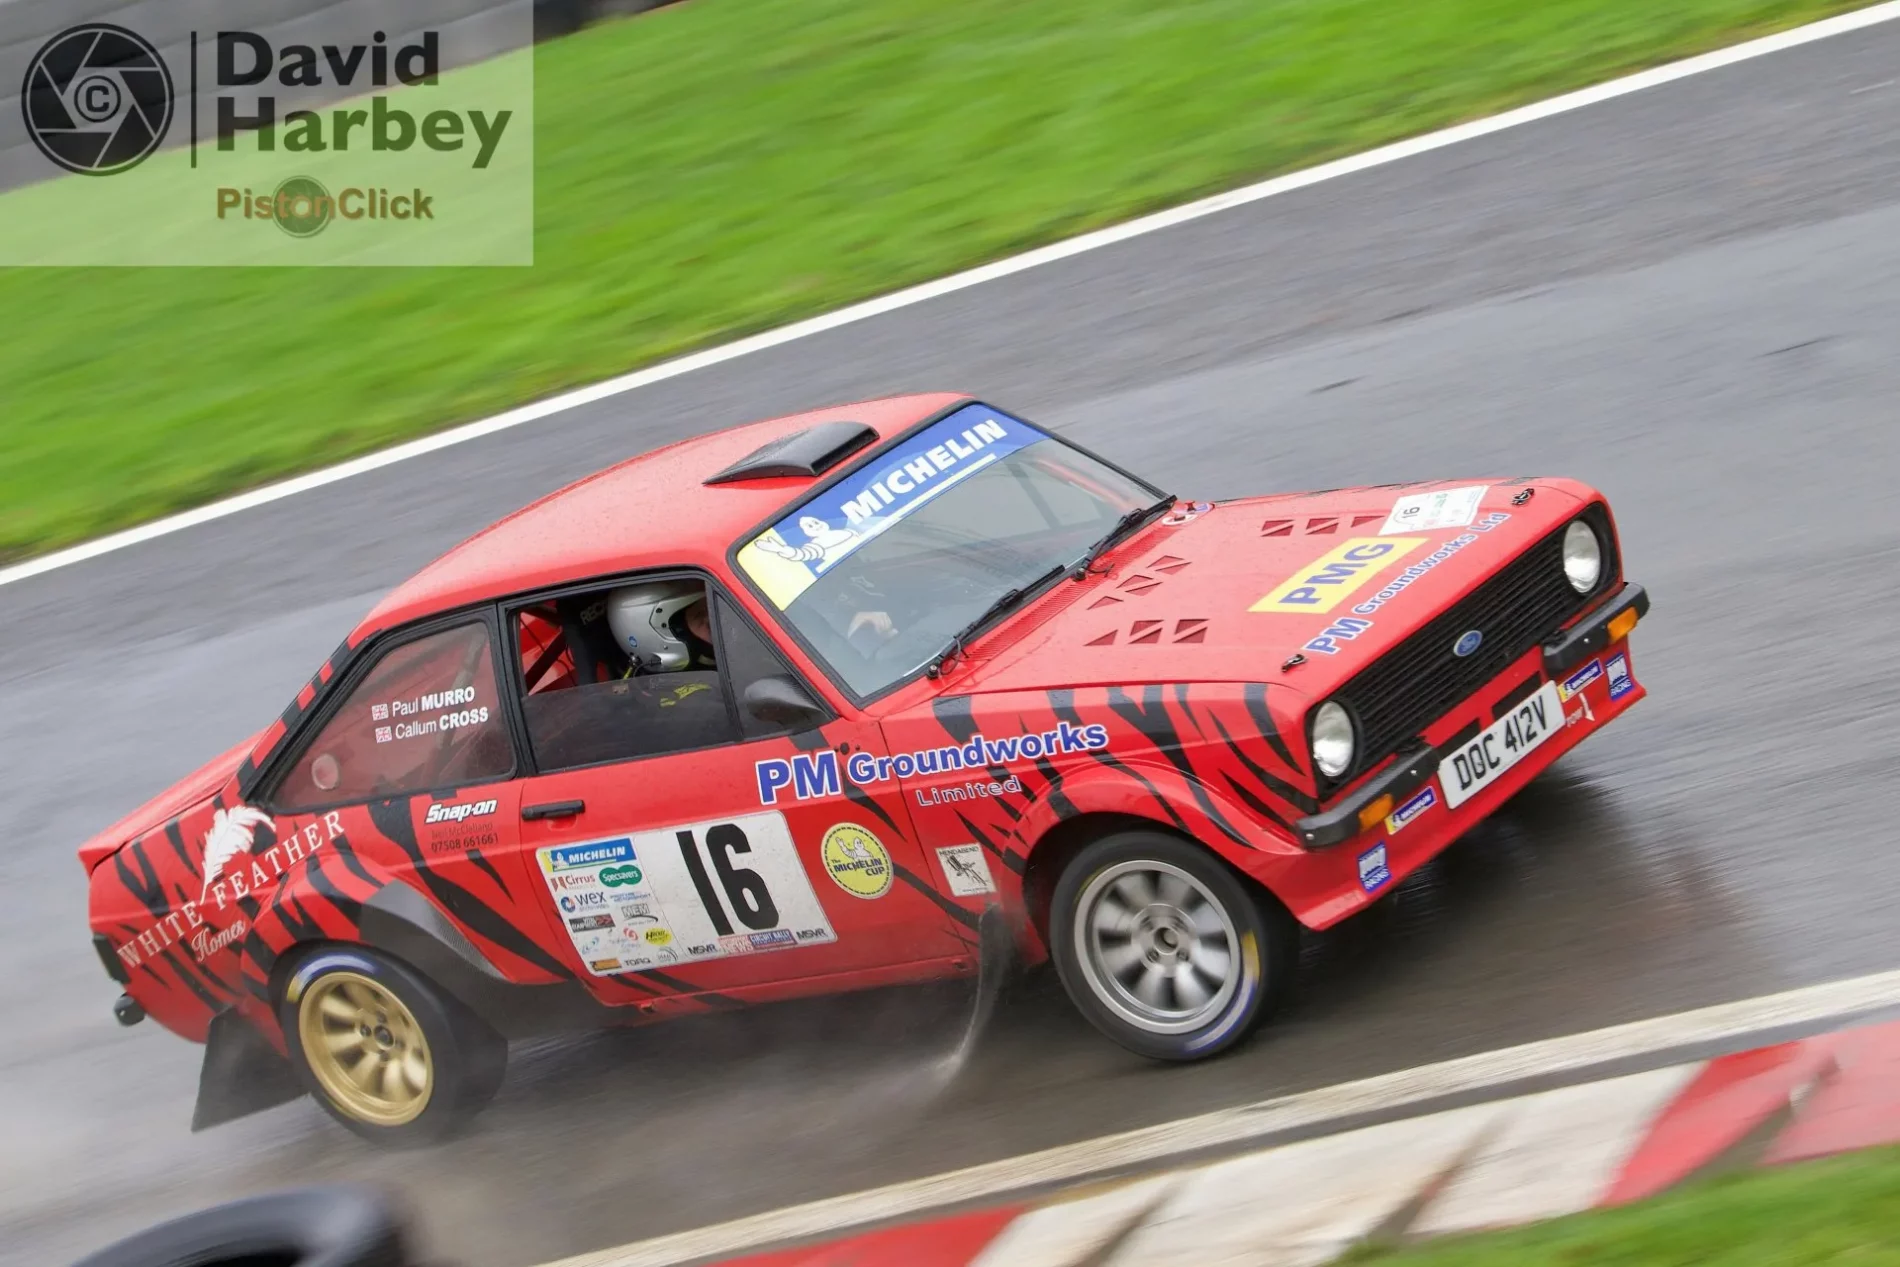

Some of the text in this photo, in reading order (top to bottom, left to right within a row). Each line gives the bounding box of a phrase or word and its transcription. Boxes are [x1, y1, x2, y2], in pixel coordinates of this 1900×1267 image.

[840, 418, 1008, 525] MICHELIN
[1278, 543, 1395, 605] PMG
[1303, 511, 1512, 656] PM Groundworks Ltd
[392, 686, 475, 717] Paul MURRO
[395, 706, 488, 739] Callum CROSS
[1504, 694, 1547, 753] 412V
[756, 720, 1109, 806] PM Groundworks
[915, 774, 1022, 807] Limited
[424, 799, 498, 824] Snap-on
[568, 846, 626, 864] MICHELIN
[833, 857, 883, 873] MICHELIN
[565, 874, 596, 886] Cirrus
[602, 870, 639, 883] Specsavers
[676, 823, 779, 937] 16
[865, 867, 885, 877] CUP
[117, 811, 345, 969] WHITE FEATHER
[575, 891, 607, 906] wex
[191, 919, 246, 963] Homes
